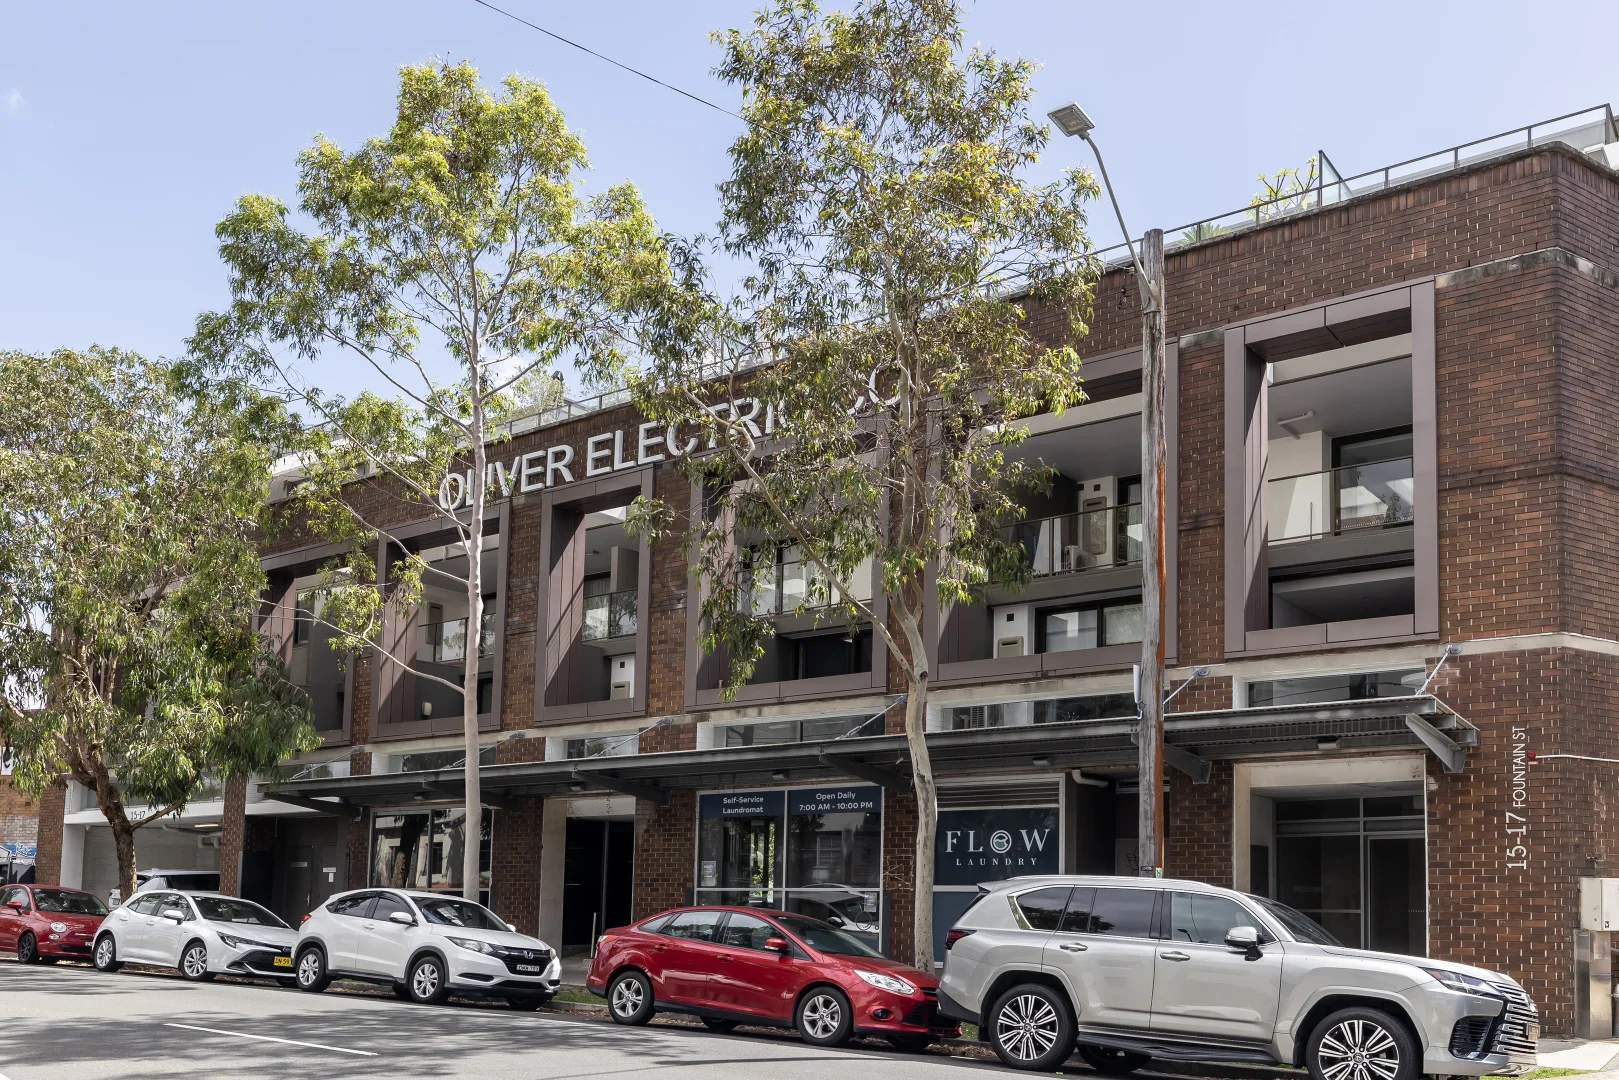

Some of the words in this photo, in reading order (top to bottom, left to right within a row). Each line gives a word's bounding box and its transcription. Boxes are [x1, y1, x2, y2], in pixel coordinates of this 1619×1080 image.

[1512, 726, 1526, 740] ST
[1512, 743, 1526, 808] FOUNTAIN
[723, 796, 764, 804] Self-Service
[816, 793, 836, 802] Open
[838, 791, 856, 800] Daily
[722, 806, 764, 814] Laundromat
[817, 803, 830, 811] AM
[837, 802, 859, 810] 10:00
[860, 801, 873, 809] PM
[945, 828, 1051, 854] FLOW
[1506, 811, 1527, 870] 15-17
[956, 857, 1038, 867] LAUNDRY
